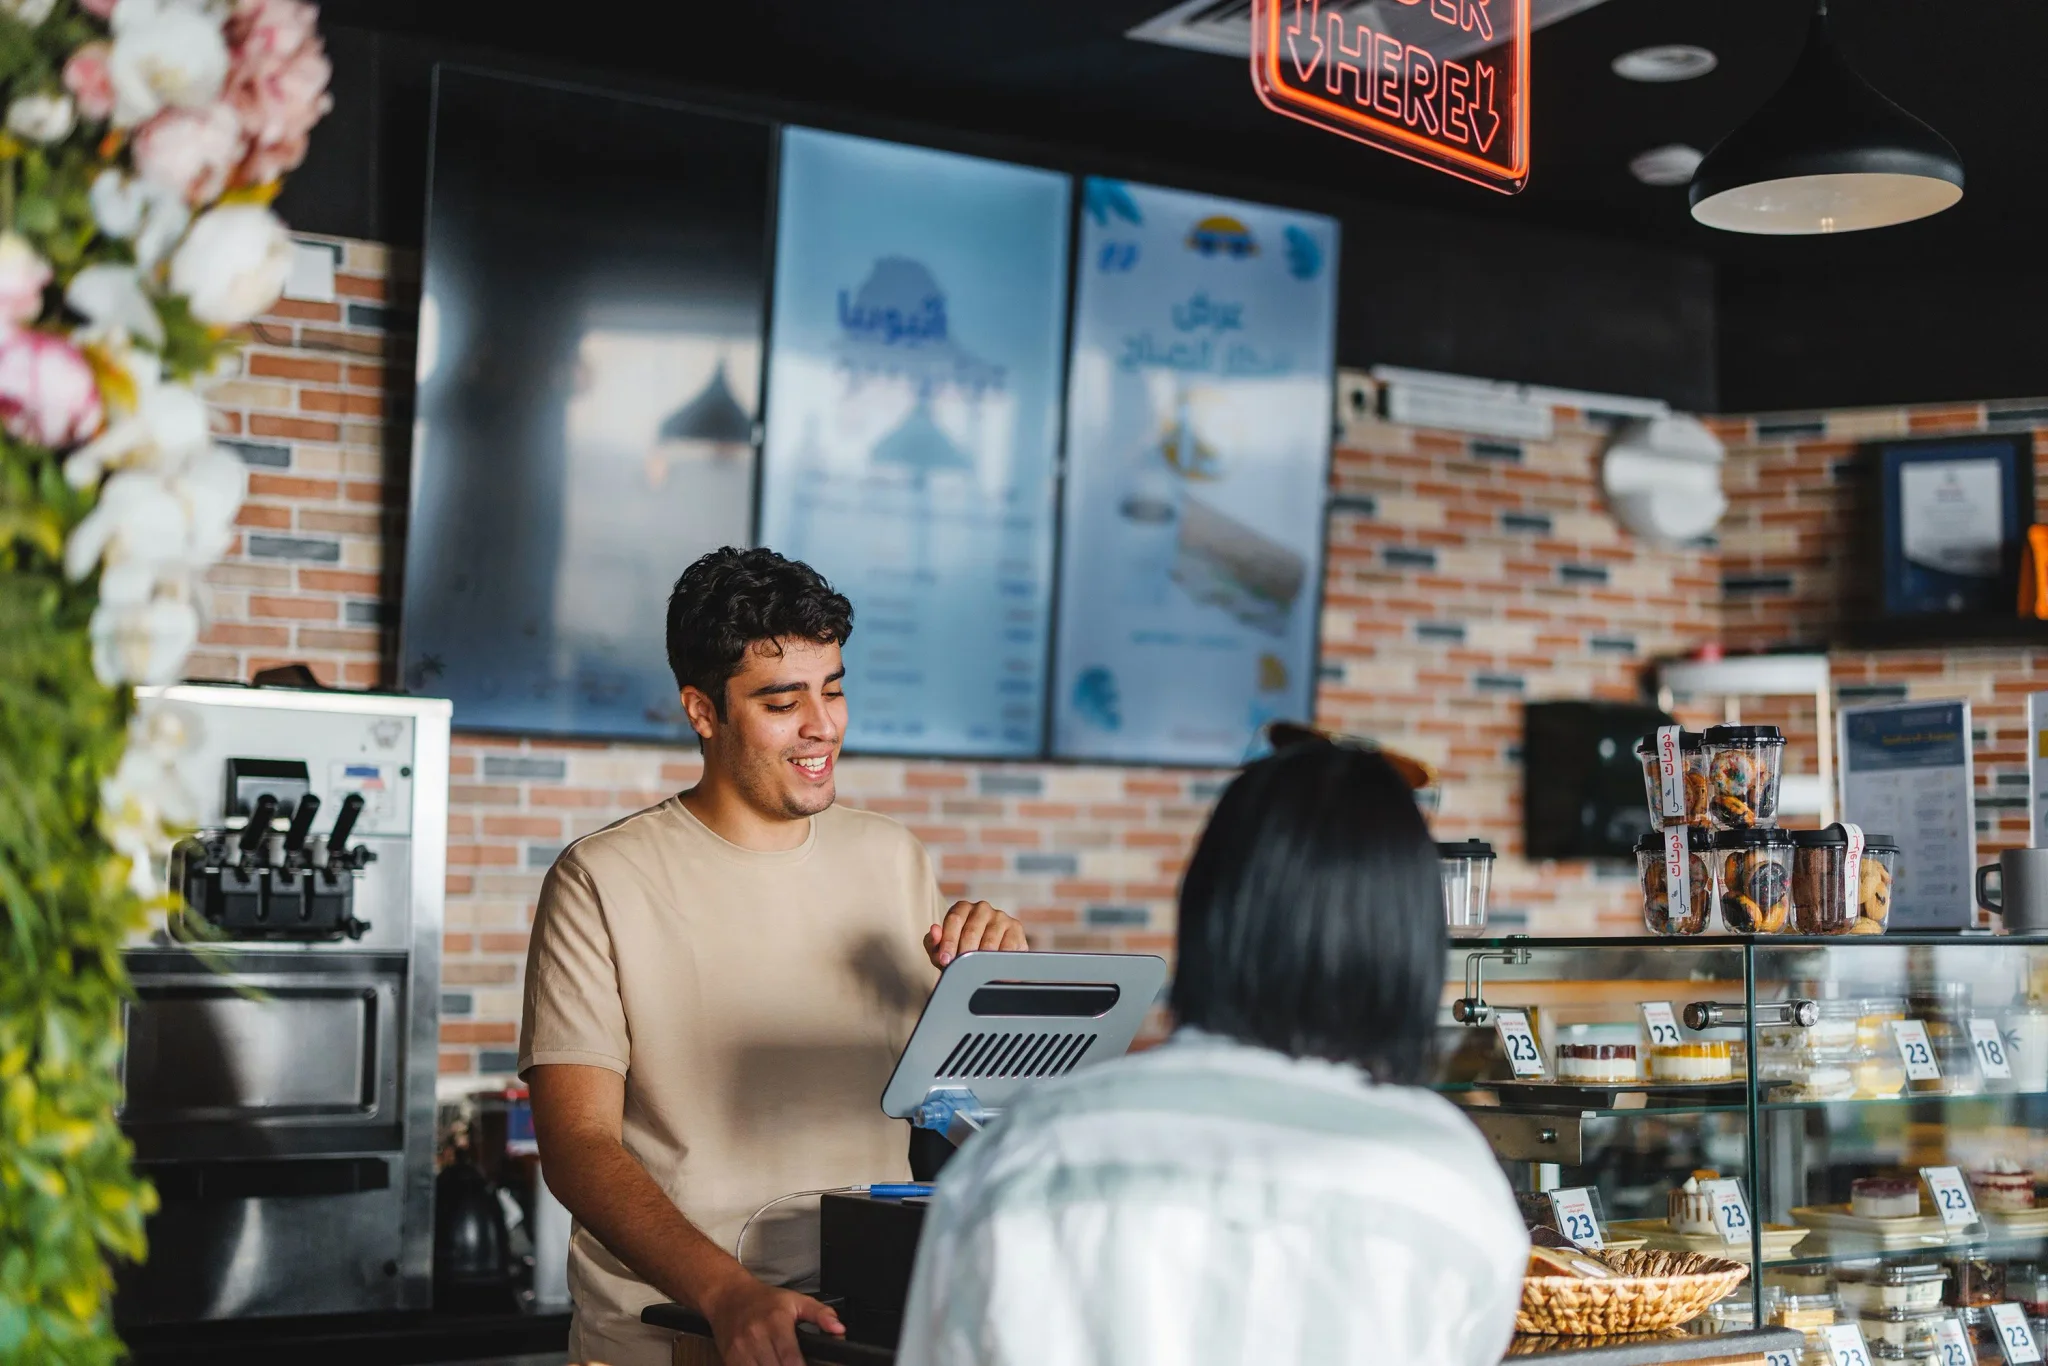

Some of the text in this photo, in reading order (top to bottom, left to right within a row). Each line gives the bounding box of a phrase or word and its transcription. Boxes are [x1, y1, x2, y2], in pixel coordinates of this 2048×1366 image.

[1326, 12, 1469, 144] HERE
[1661, 733, 1675, 777] دونات
[1668, 834, 1683, 877] دونات
[1506, 1034, 1538, 1061] 23
[1905, 1043, 1930, 1064] 23
[1976, 1039, 2004, 1066] 18
[1941, 1188, 1967, 1210] 23
[1566, 1213, 1595, 1240] 23
[1722, 1204, 1746, 1228] 23
[2006, 1326, 2030, 1348] 23
[1944, 1343, 1966, 1366] 23
